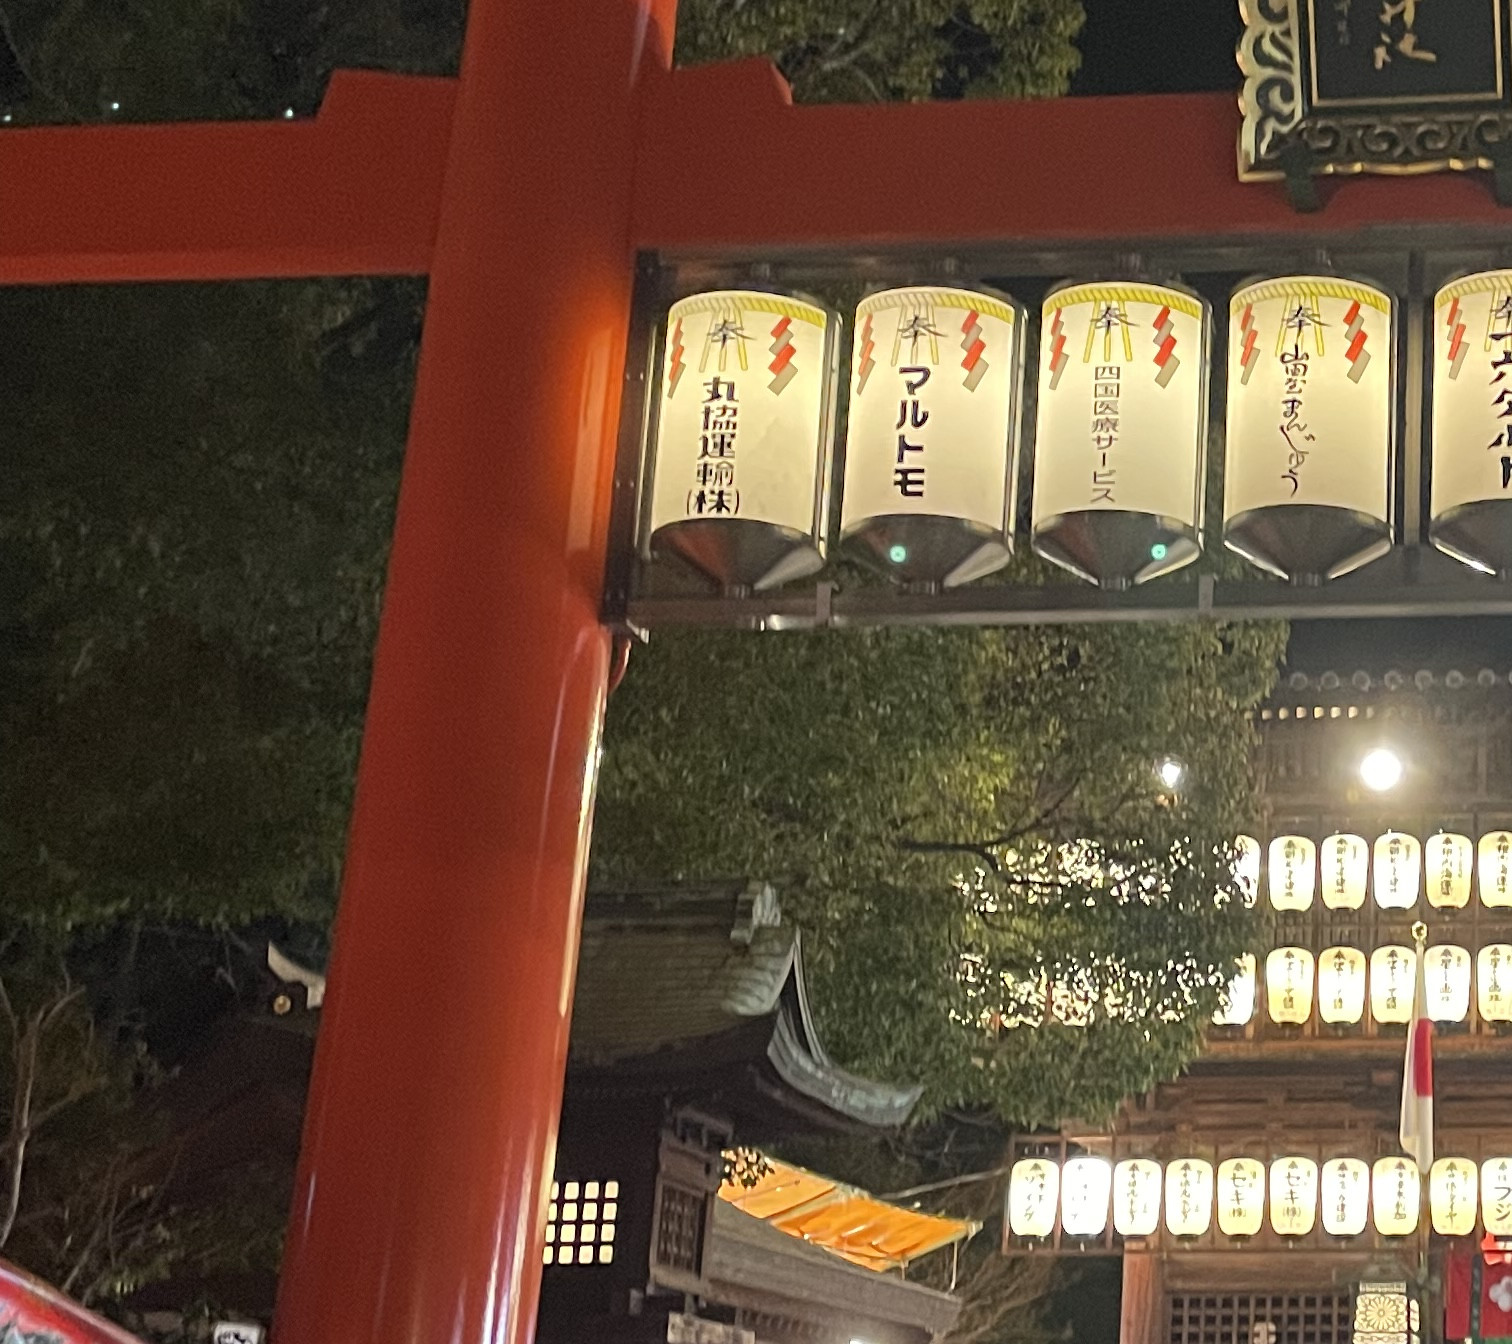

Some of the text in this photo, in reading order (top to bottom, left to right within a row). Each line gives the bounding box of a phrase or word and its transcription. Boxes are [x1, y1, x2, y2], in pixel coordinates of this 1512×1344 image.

[893, 366, 932, 498] マルトモ
[1090, 365, 1121, 504] 四国医療サービス
